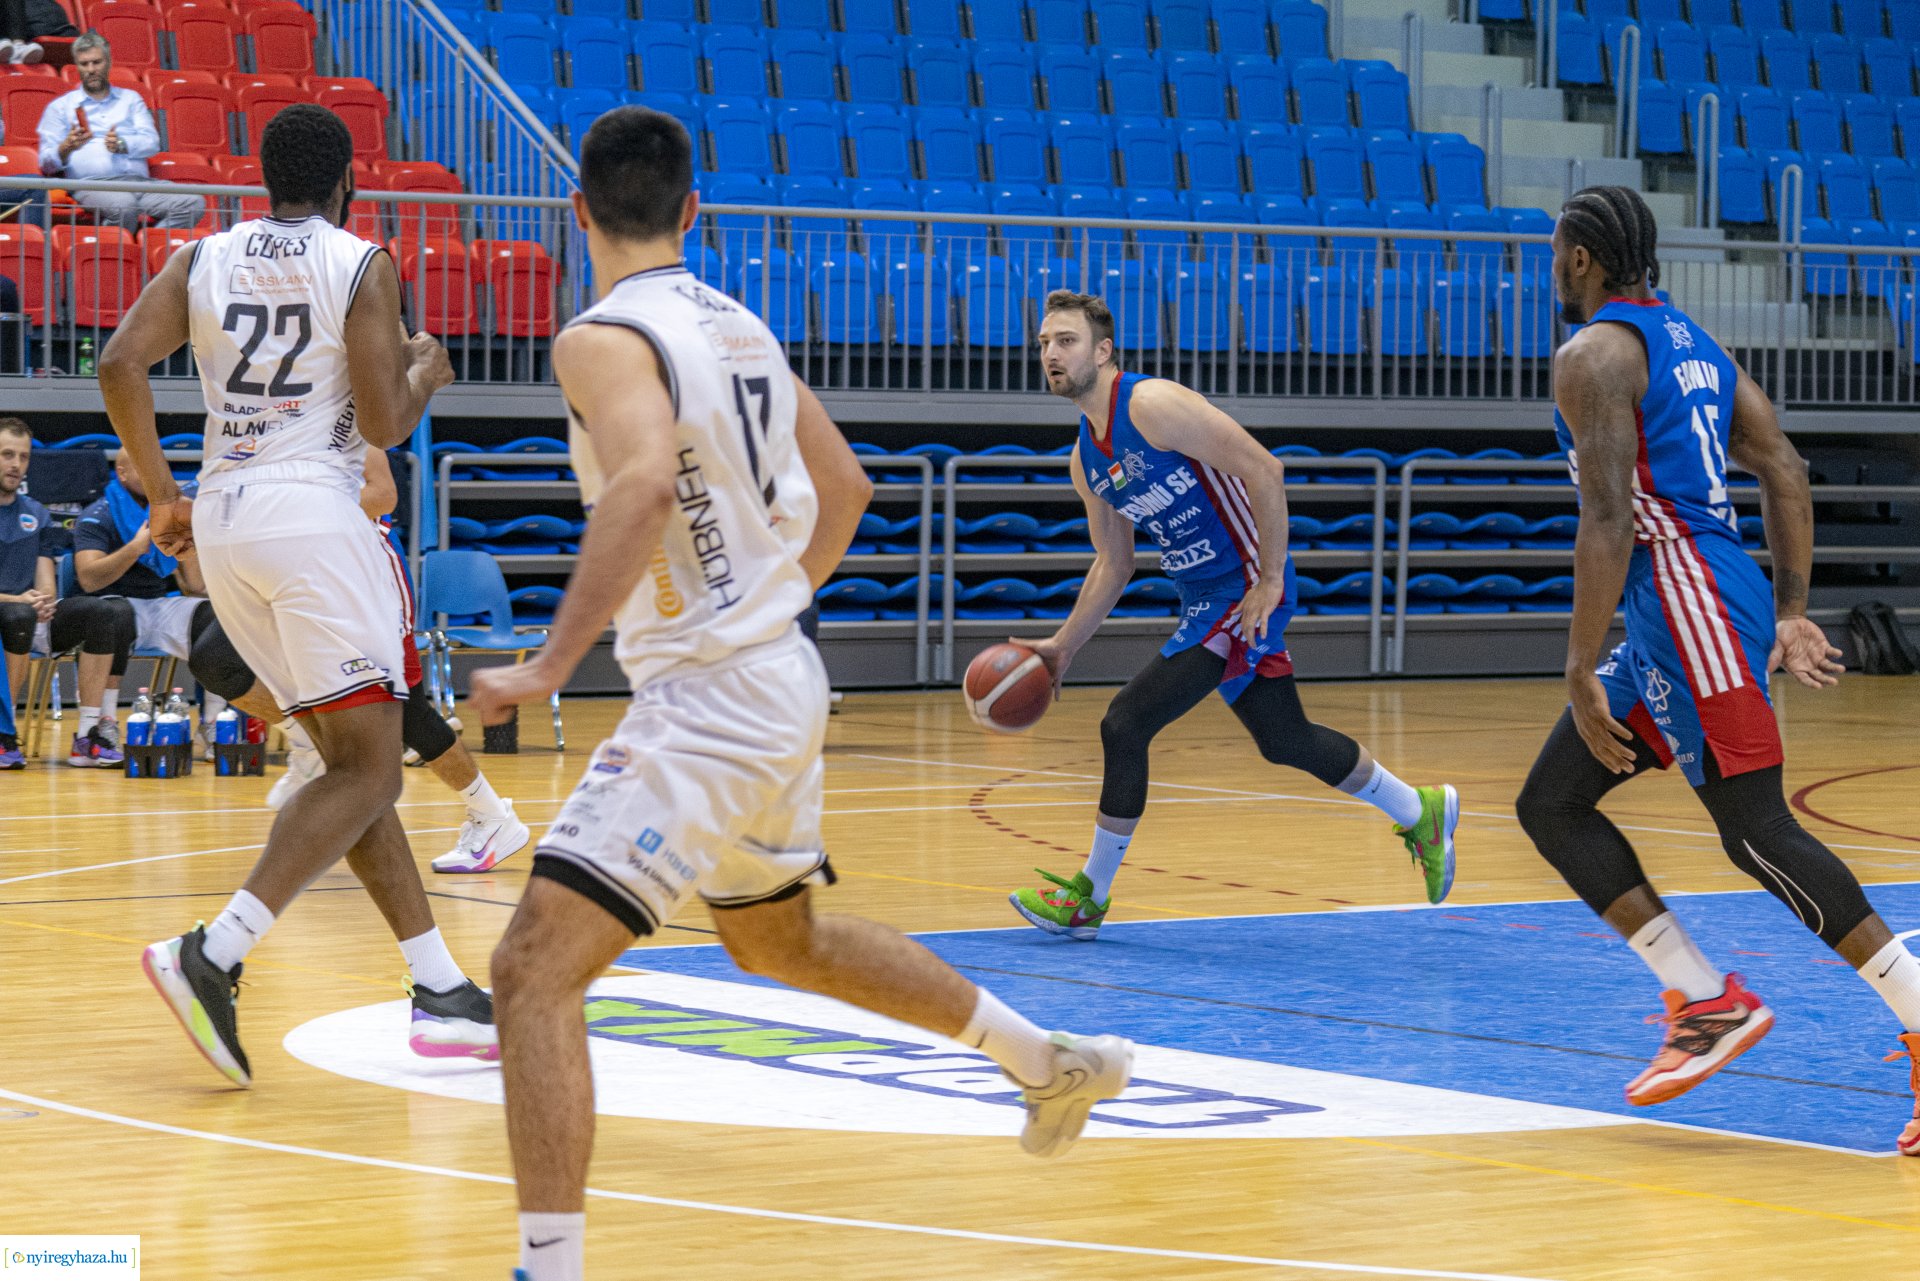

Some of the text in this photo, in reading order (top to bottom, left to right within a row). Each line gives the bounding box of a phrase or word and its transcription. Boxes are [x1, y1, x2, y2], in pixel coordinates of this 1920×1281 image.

[223, 302, 312, 397] 22
[327, 396, 357, 453] YÍREGY
[1165, 465, 1198, 495] SE
[1168, 505, 1202, 529] MVM
